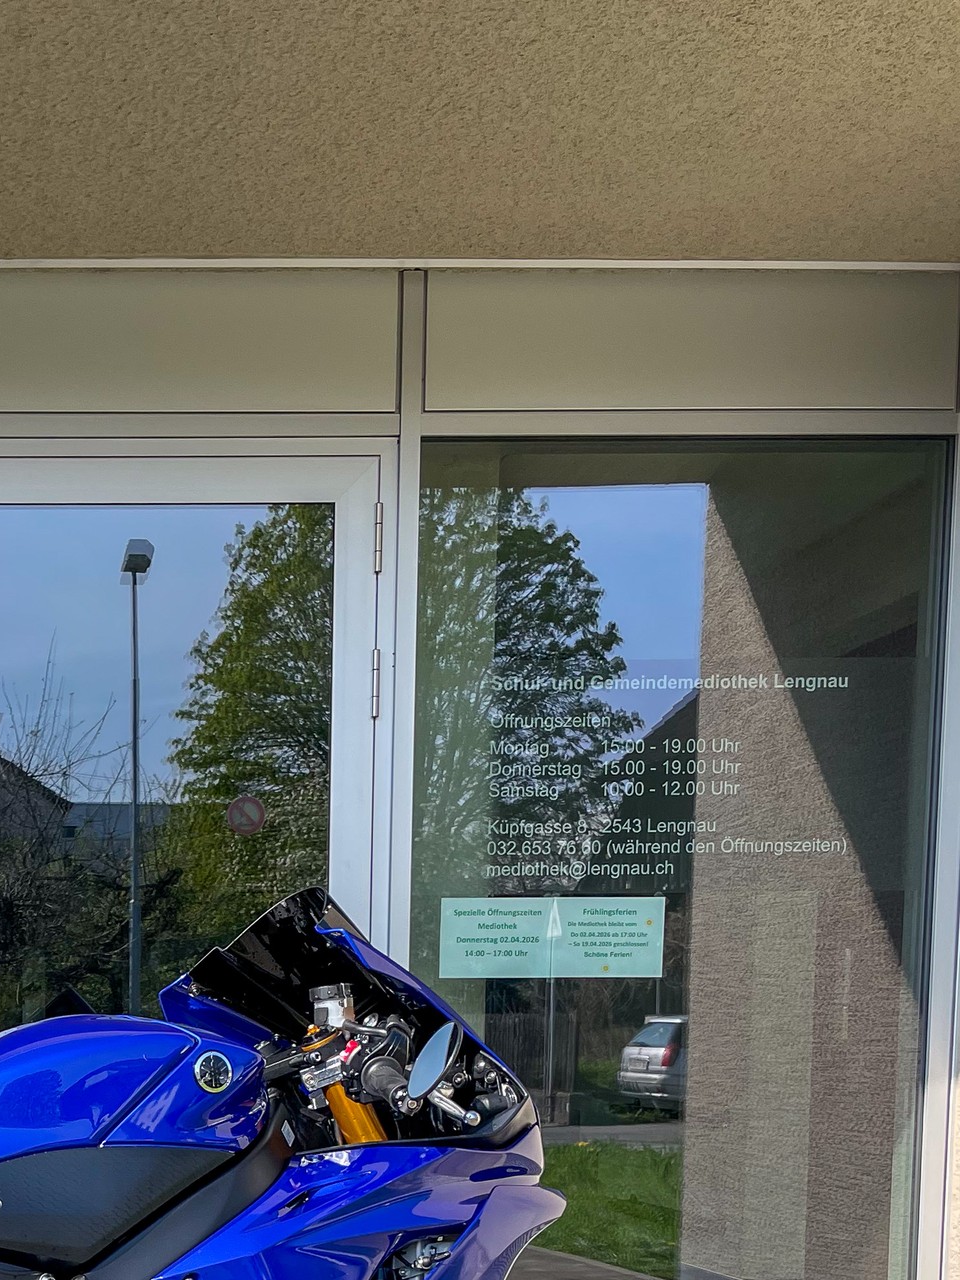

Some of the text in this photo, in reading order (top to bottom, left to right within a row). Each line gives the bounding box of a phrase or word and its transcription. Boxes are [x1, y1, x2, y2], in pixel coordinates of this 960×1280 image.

[552, 675, 585, 691] und
[591, 674, 768, 690] Gemeindemediothek
[774, 674, 849, 692] Lengnau
[490, 740, 550, 759] Montag
[601, 739, 645, 754] 15.00
[662, 738, 706, 754] 19.00
[712, 738, 740, 753] Uhr
[490, 761, 582, 779] Donnerstag
[602, 760, 645, 776] 15.00
[662, 760, 706, 775] 19.00
[712, 760, 741, 774] Uhr
[488, 782, 559, 800] Samstag
[601, 781, 645, 797] 10.00
[661, 781, 706, 796] 12.00
[711, 780, 740, 795] Uhr
[487, 820, 572, 838] Küpfgasse
[601, 819, 642, 834] 2543
[647, 818, 716, 836] Lengnau
[557, 840, 576, 855] 76
[581, 839, 601, 855] 60
[606, 838, 680, 859] (während
[685, 839, 715, 854] den
[720, 836, 847, 857] Öffnungszeiten)
[486, 860, 674, 879] mediothek@lengnau.ch
[453, 907, 542, 917] Spezielle Öffnungszeiten
[582, 908, 637, 917] Frühlingsferien
[477, 922, 517, 930] Mediothek
[456, 936, 540, 944] Donnerstag 02.04.2026
[464, 949, 485, 957] 14:00
[493, 949, 513, 957] 17:00
[514, 949, 529, 957] Uhr
